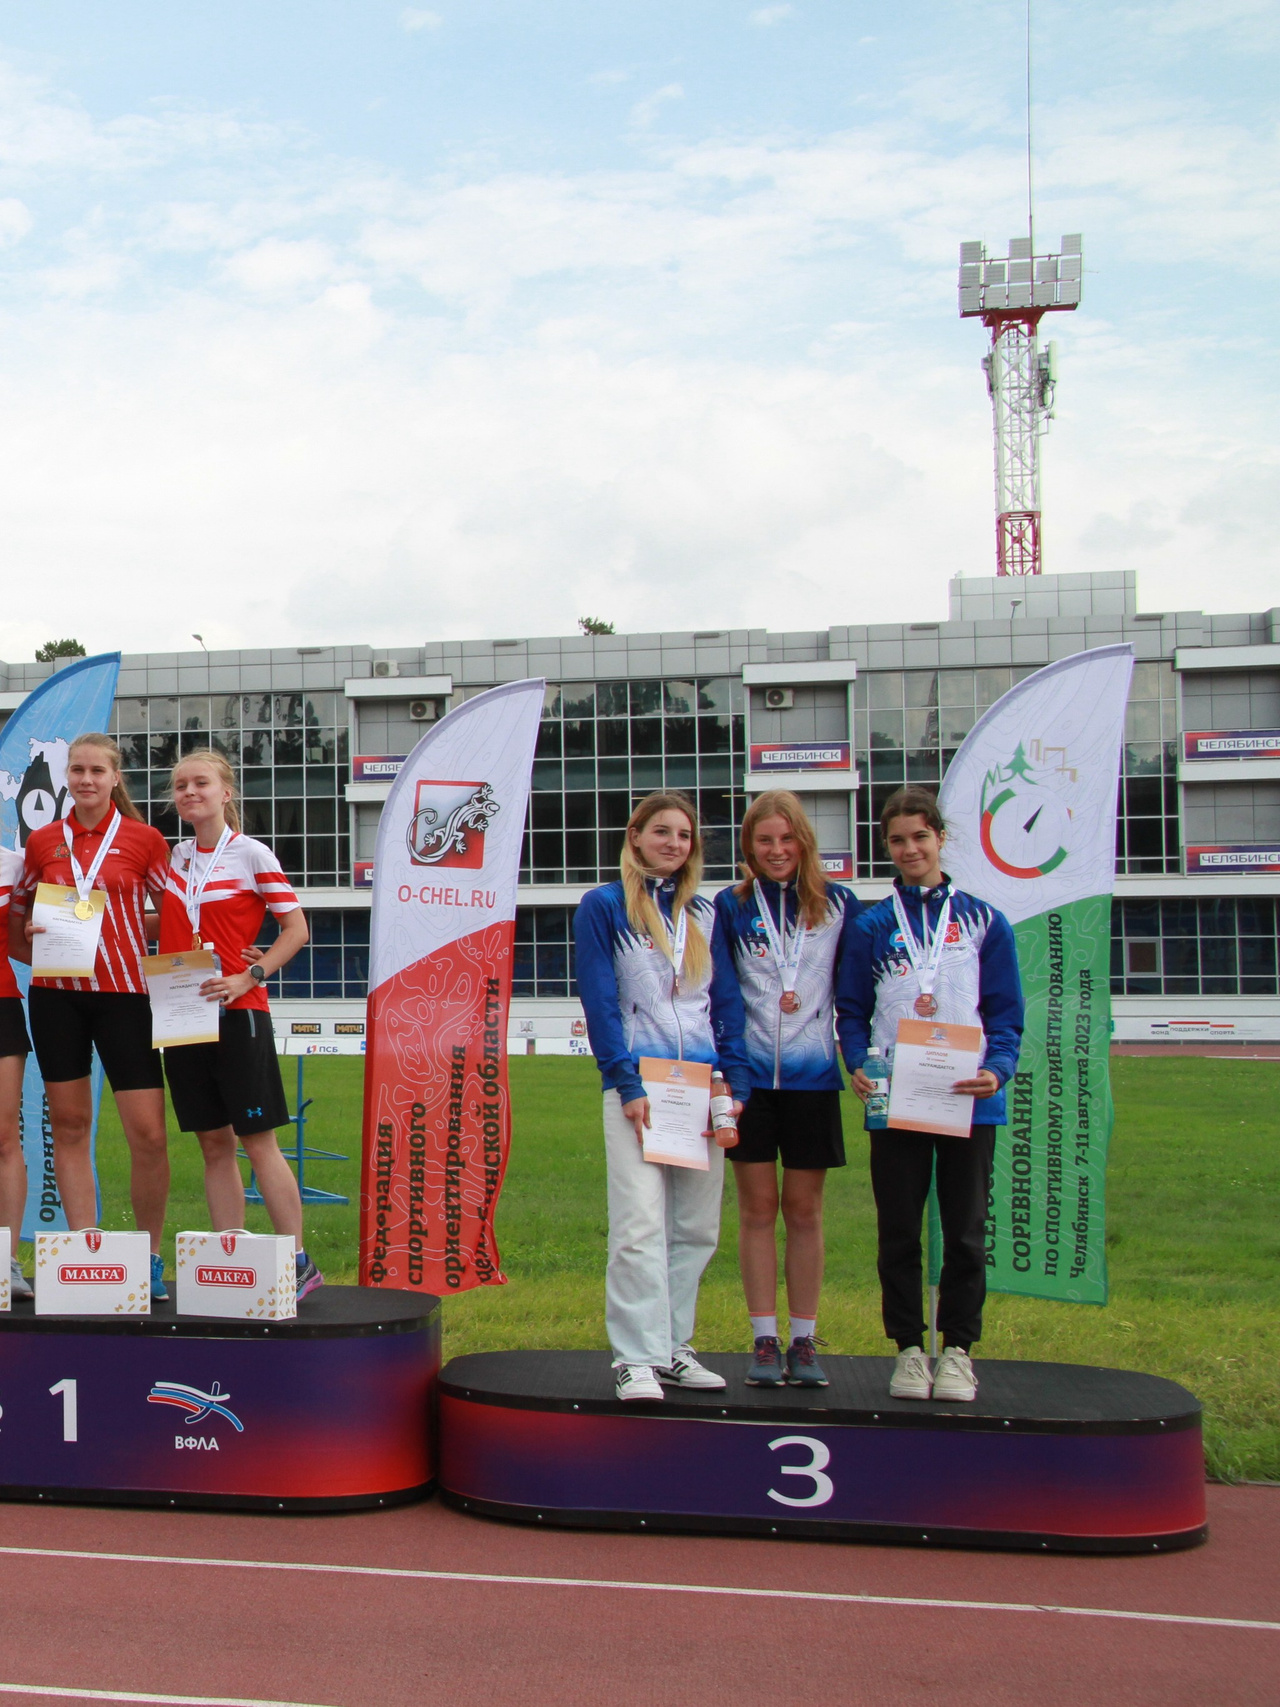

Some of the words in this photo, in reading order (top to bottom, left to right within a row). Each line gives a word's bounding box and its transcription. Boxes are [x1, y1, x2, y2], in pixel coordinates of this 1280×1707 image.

[763, 751, 839, 762] ЧЕЛЯБИНСК
[398, 885, 496, 909] O-CHEL.RU
[1046, 913, 1064, 1098] ОРИЕНТИРОВАНИЮ
[1079, 968, 1094, 1011] года
[476, 977, 500, 1097] области
[1074, 1013, 1091, 1055] 2023
[1077, 1058, 1093, 1130] августа
[445, 1044, 466, 1289] ориентирования
[1012, 1071, 1034, 1273] СОРЕВНОВАНИЯ
[1045, 1100, 1063, 1245] СПОРТИВНОМУ
[1075, 1132, 1090, 1166] 7-11
[407, 1102, 428, 1286] спортивного
[1069, 1175, 1089, 1279] Челябинск
[65, 1269, 120, 1281] MAKFA
[202, 1271, 248, 1284] MAKFA
[1044, 1248, 1060, 1277] ПО
[48, 1378, 77, 1442] 1
[174, 1435, 220, 1451] ВФЛА
[766, 1435, 834, 1508] 3
